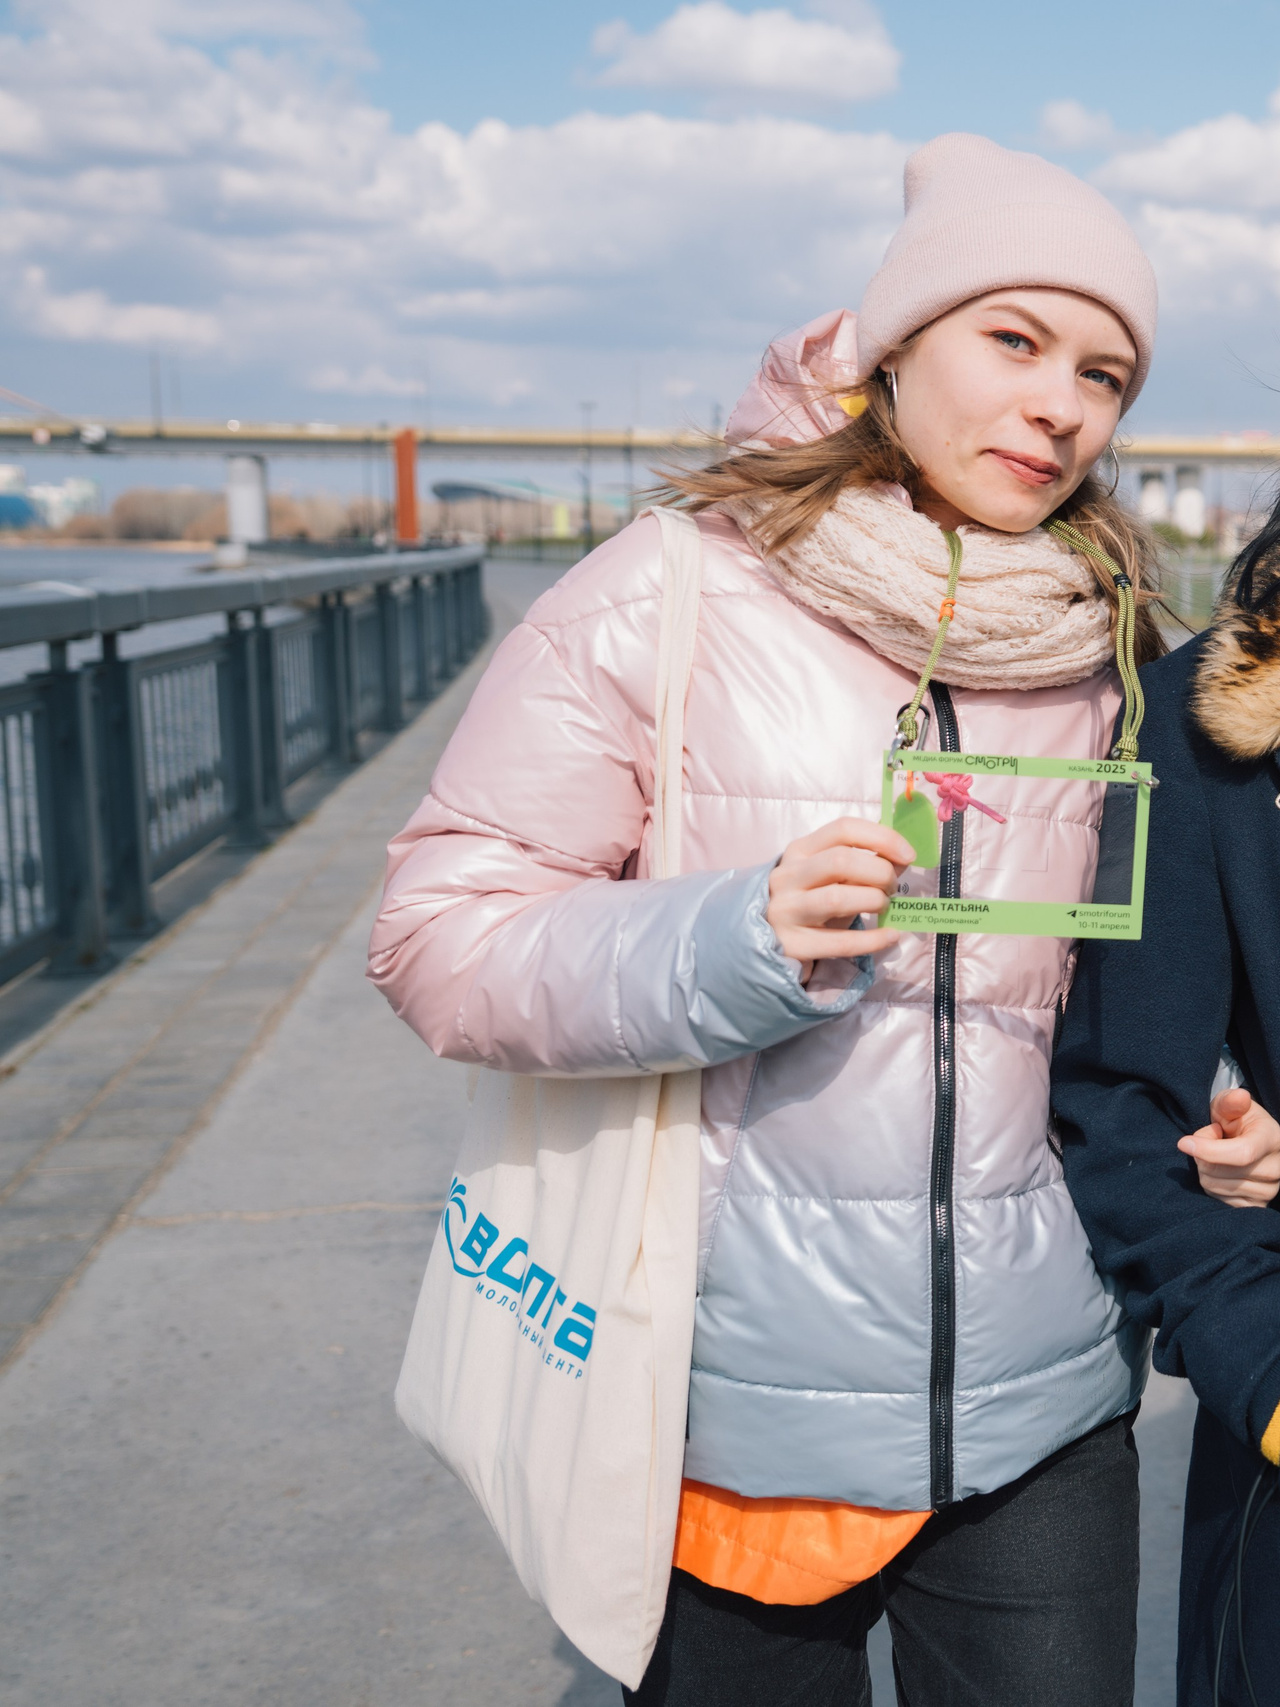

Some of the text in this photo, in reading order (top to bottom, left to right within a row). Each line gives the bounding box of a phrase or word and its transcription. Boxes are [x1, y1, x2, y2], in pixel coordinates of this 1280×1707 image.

[913, 755, 1018, 775] МЕДИА ФОРУМ СМОТРИ
[1096, 763, 1127, 774] 2025
[890, 900, 990, 913] ТЮХОВА ТАТЬЯНА
[890, 914, 907, 922] БУЗ
[1079, 910, 1130, 919] smotriforum
[1078, 920, 1130, 931] 10-11 апреля
[541, 1347, 584, 1380] ЕНТР
